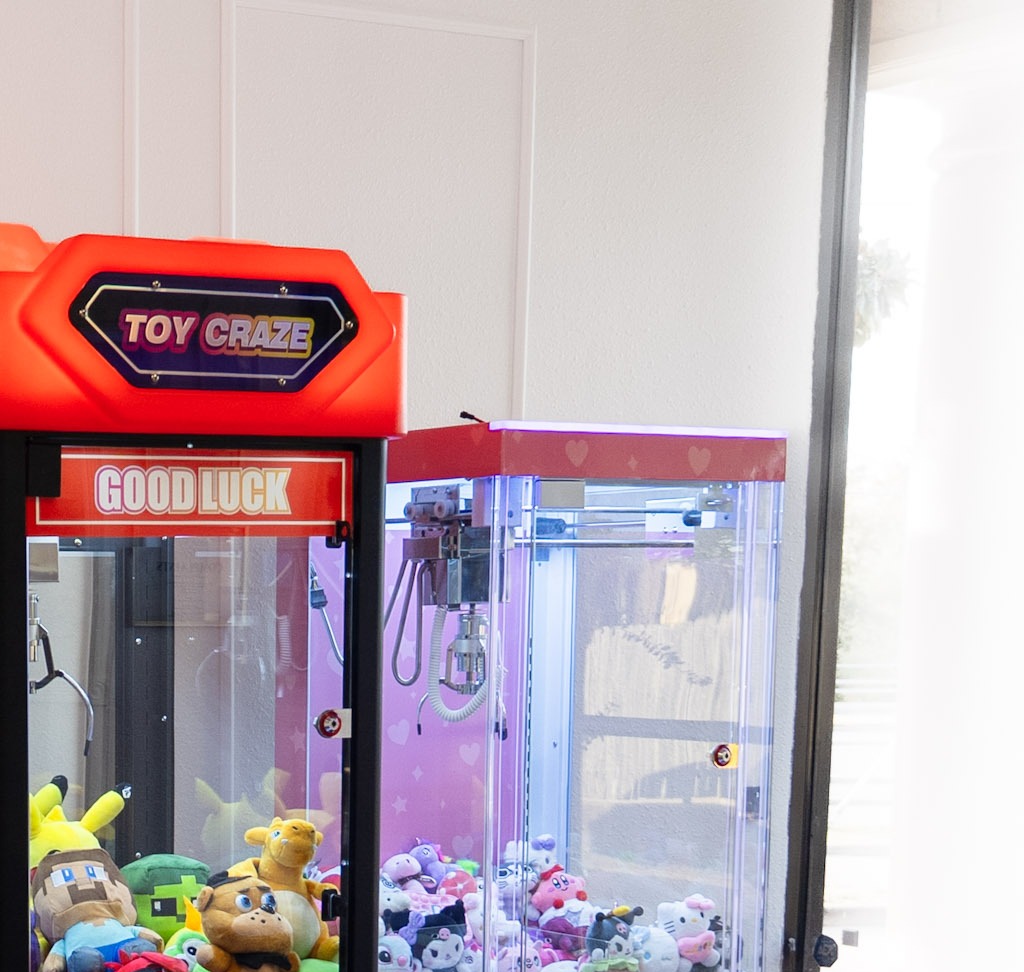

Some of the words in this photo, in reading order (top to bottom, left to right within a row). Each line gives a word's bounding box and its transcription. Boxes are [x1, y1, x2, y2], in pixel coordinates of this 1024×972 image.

[123, 311, 198, 347] TOY
[202, 315, 312, 353] CRAZE
[95, 465, 196, 514] GOOD
[198, 467, 292, 514] LUCK
